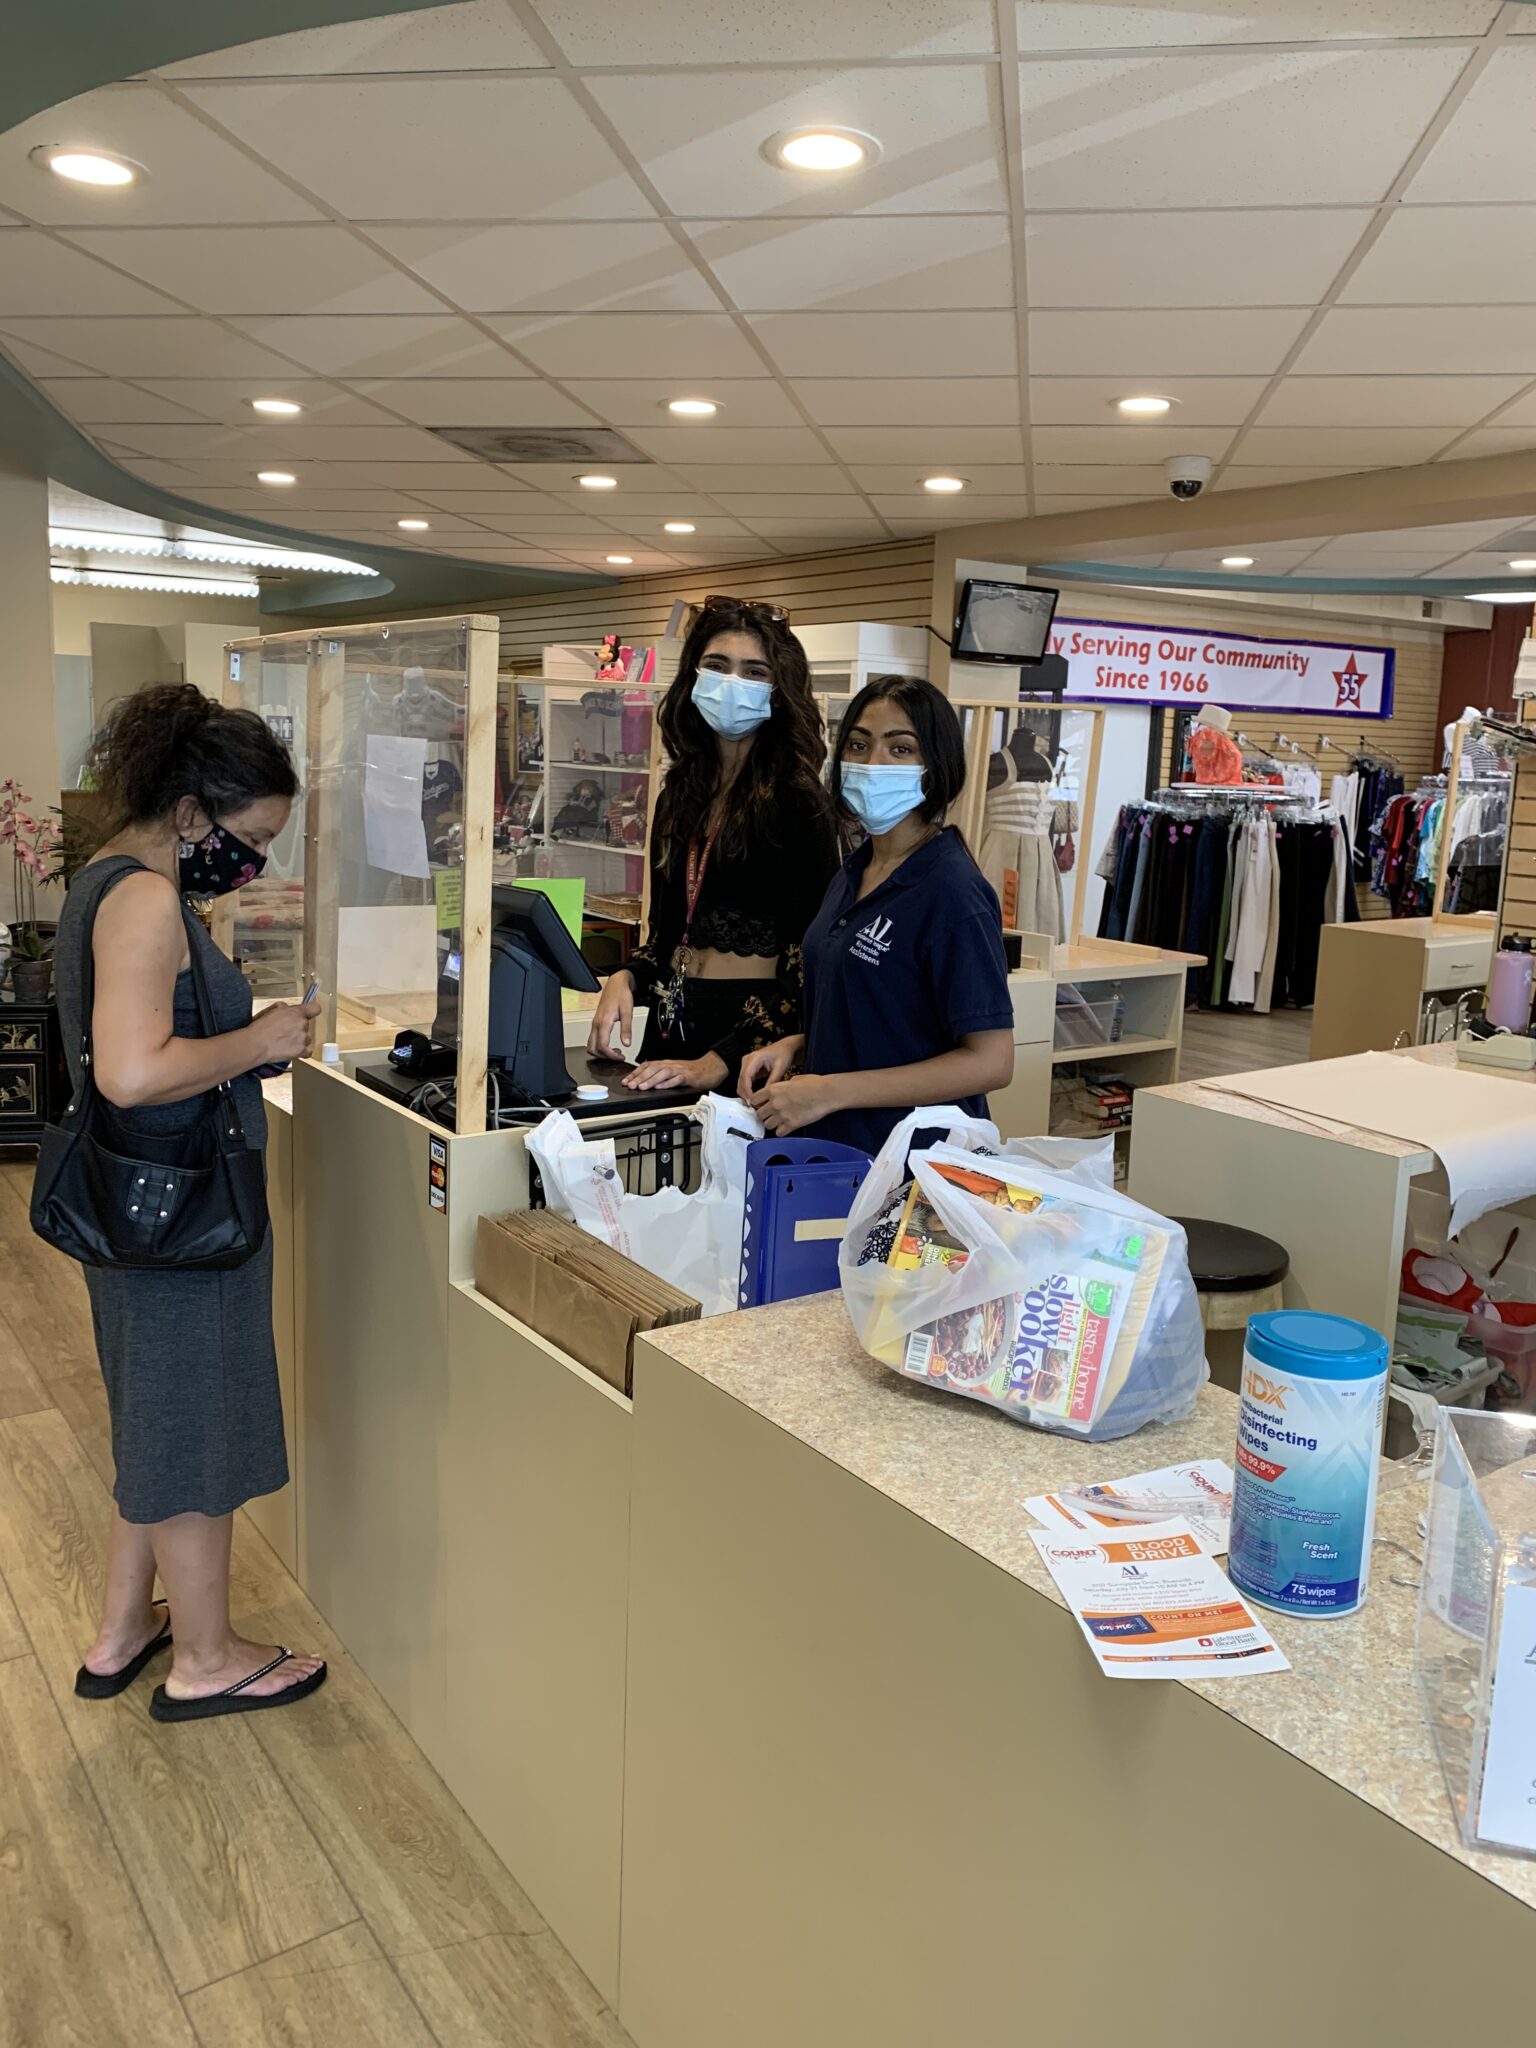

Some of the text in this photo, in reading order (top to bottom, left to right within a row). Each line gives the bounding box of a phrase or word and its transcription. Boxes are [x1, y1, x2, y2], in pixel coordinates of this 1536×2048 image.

[1070, 632, 1151, 666] Serving
[1158, 639, 1198, 662] Our
[1202, 643, 1310, 678] Community
[1095, 666, 1209, 694] Since 1966
[1339, 673, 1360, 700] 55
[855, 940, 880, 957] Riverside
[432, 1146, 444, 1160] VISA
[1040, 1274, 1074, 1346] slow
[1058, 1300, 1082, 1342] light
[1083, 1319, 1100, 1354] taste
[1006, 1340, 1016, 1366] RECIPE
[1072, 1364, 1097, 1410] home
[1240, 1407, 1318, 1450] Disinfecting
[1240, 1422, 1269, 1452] Wipes
[1248, 1455, 1276, 1475] 99.9%
[1189, 1471, 1222, 1495] COUNT
[1258, 1509, 1272, 1520] Virus
[1050, 1548, 1098, 1558] COUNT
[1126, 1536, 1186, 1552] BLOOD
[1132, 1546, 1194, 1560] DRIVE
[1302, 1541, 1330, 1551] Fresh
[1310, 1551, 1338, 1560] Scent
[1292, 1584, 1336, 1598] 75 wipes
